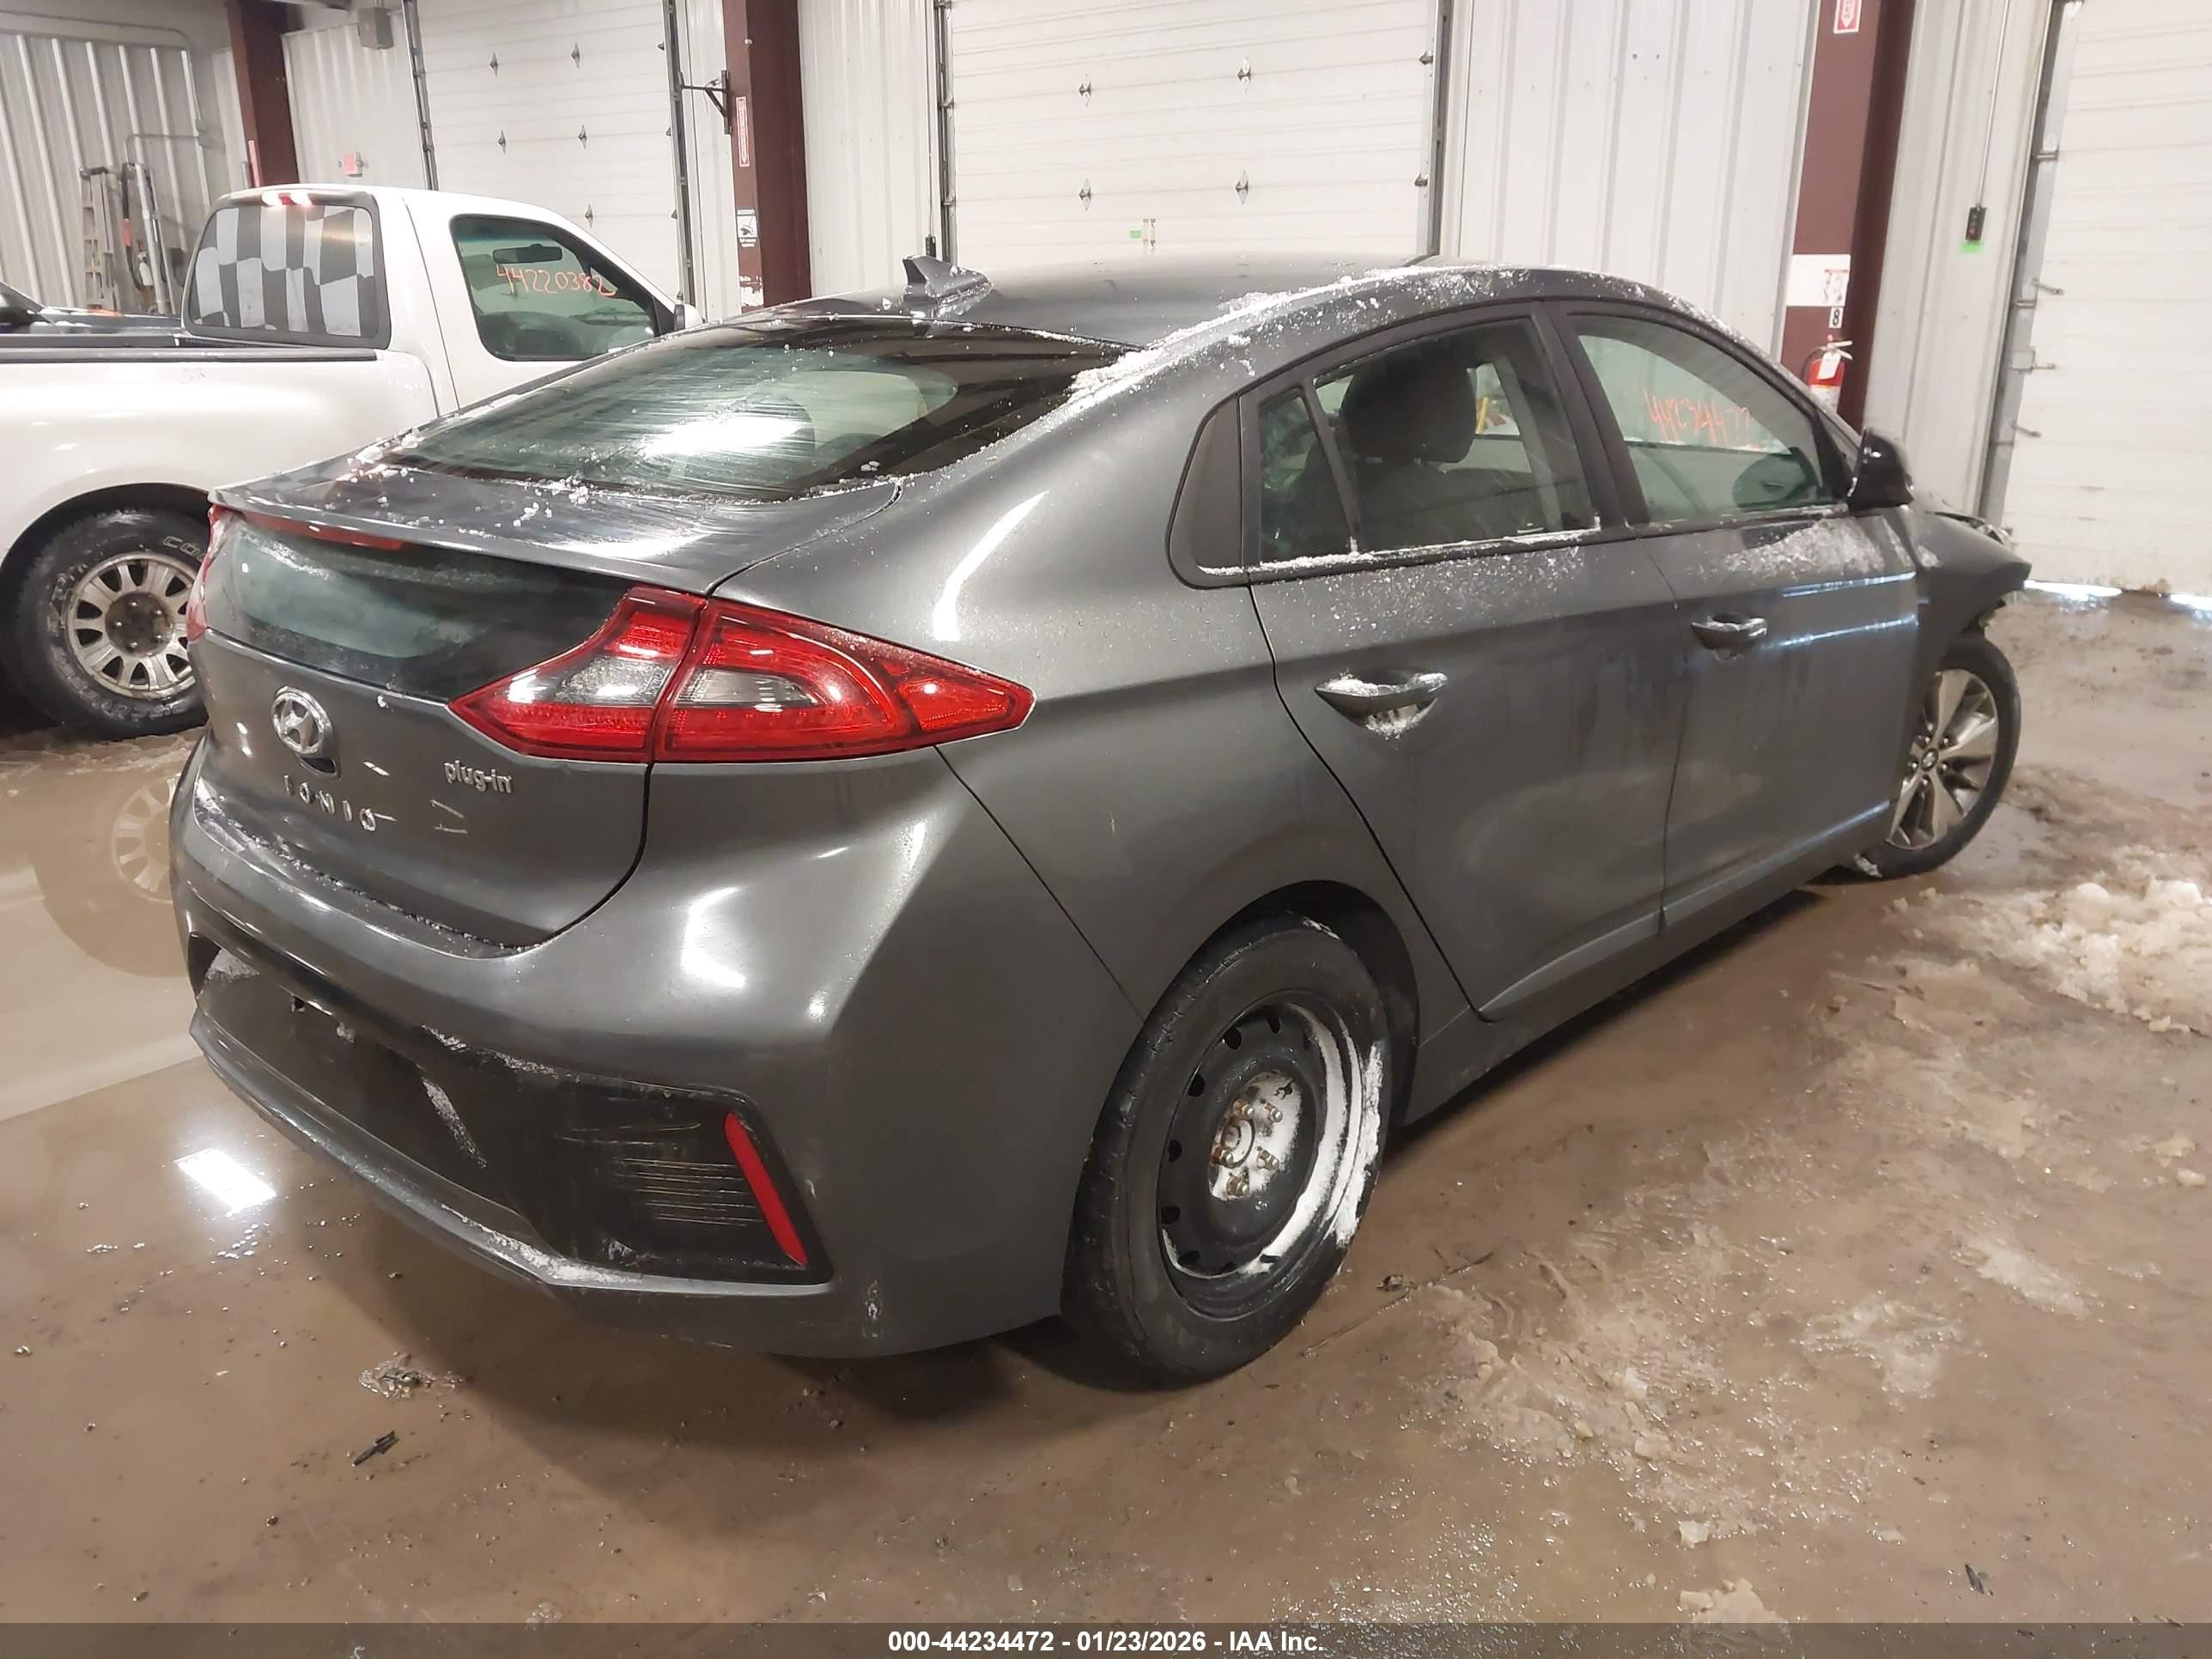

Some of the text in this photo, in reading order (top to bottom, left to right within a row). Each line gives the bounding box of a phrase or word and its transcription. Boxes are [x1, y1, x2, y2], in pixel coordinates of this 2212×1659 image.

[496, 264, 617, 296] 44220382
[1832, 309, 1840, 326] 8
[444, 759, 513, 793] plug-in
